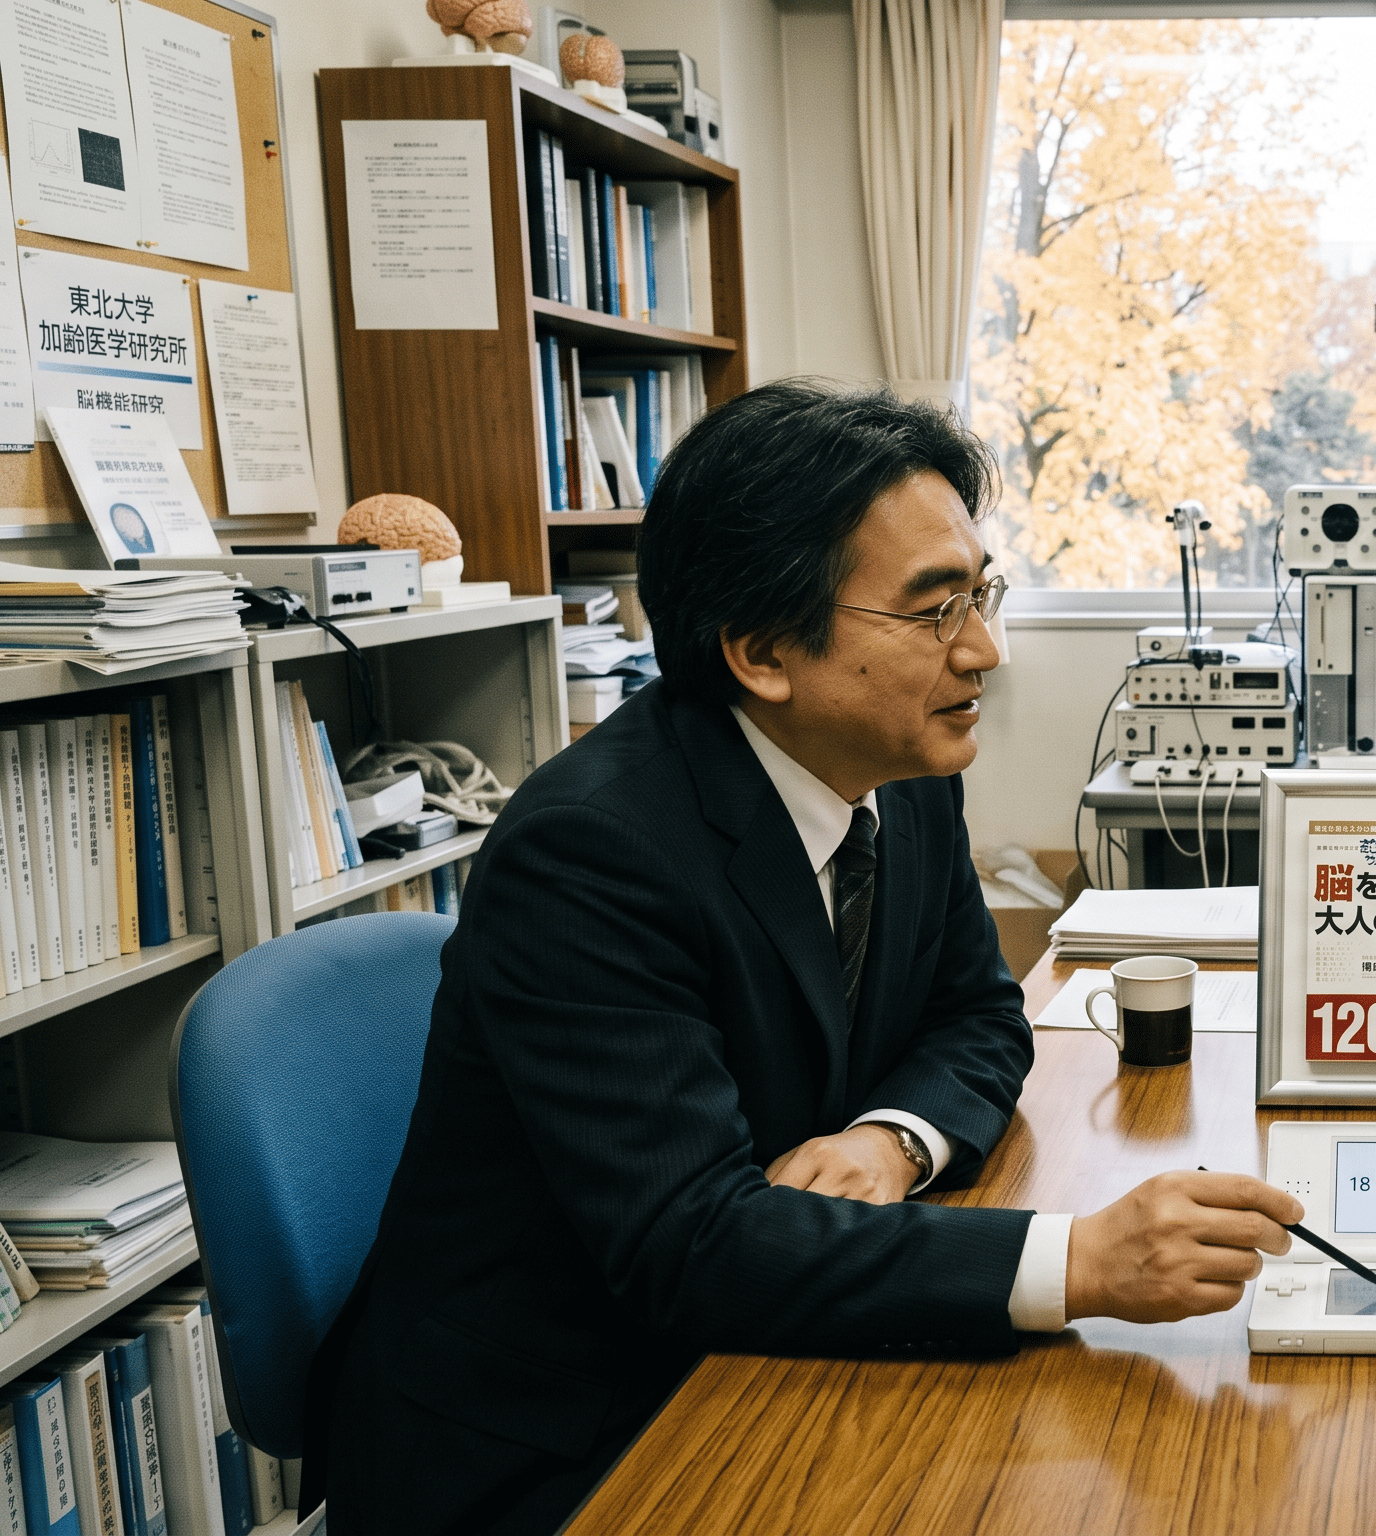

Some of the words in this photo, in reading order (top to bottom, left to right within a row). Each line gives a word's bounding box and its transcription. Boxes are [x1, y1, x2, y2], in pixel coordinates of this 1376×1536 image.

[68, 285, 155, 324] 東北大学
[39, 319, 187, 366] 加齢医学研究所
[1349, 1176, 1371, 1192] 18
